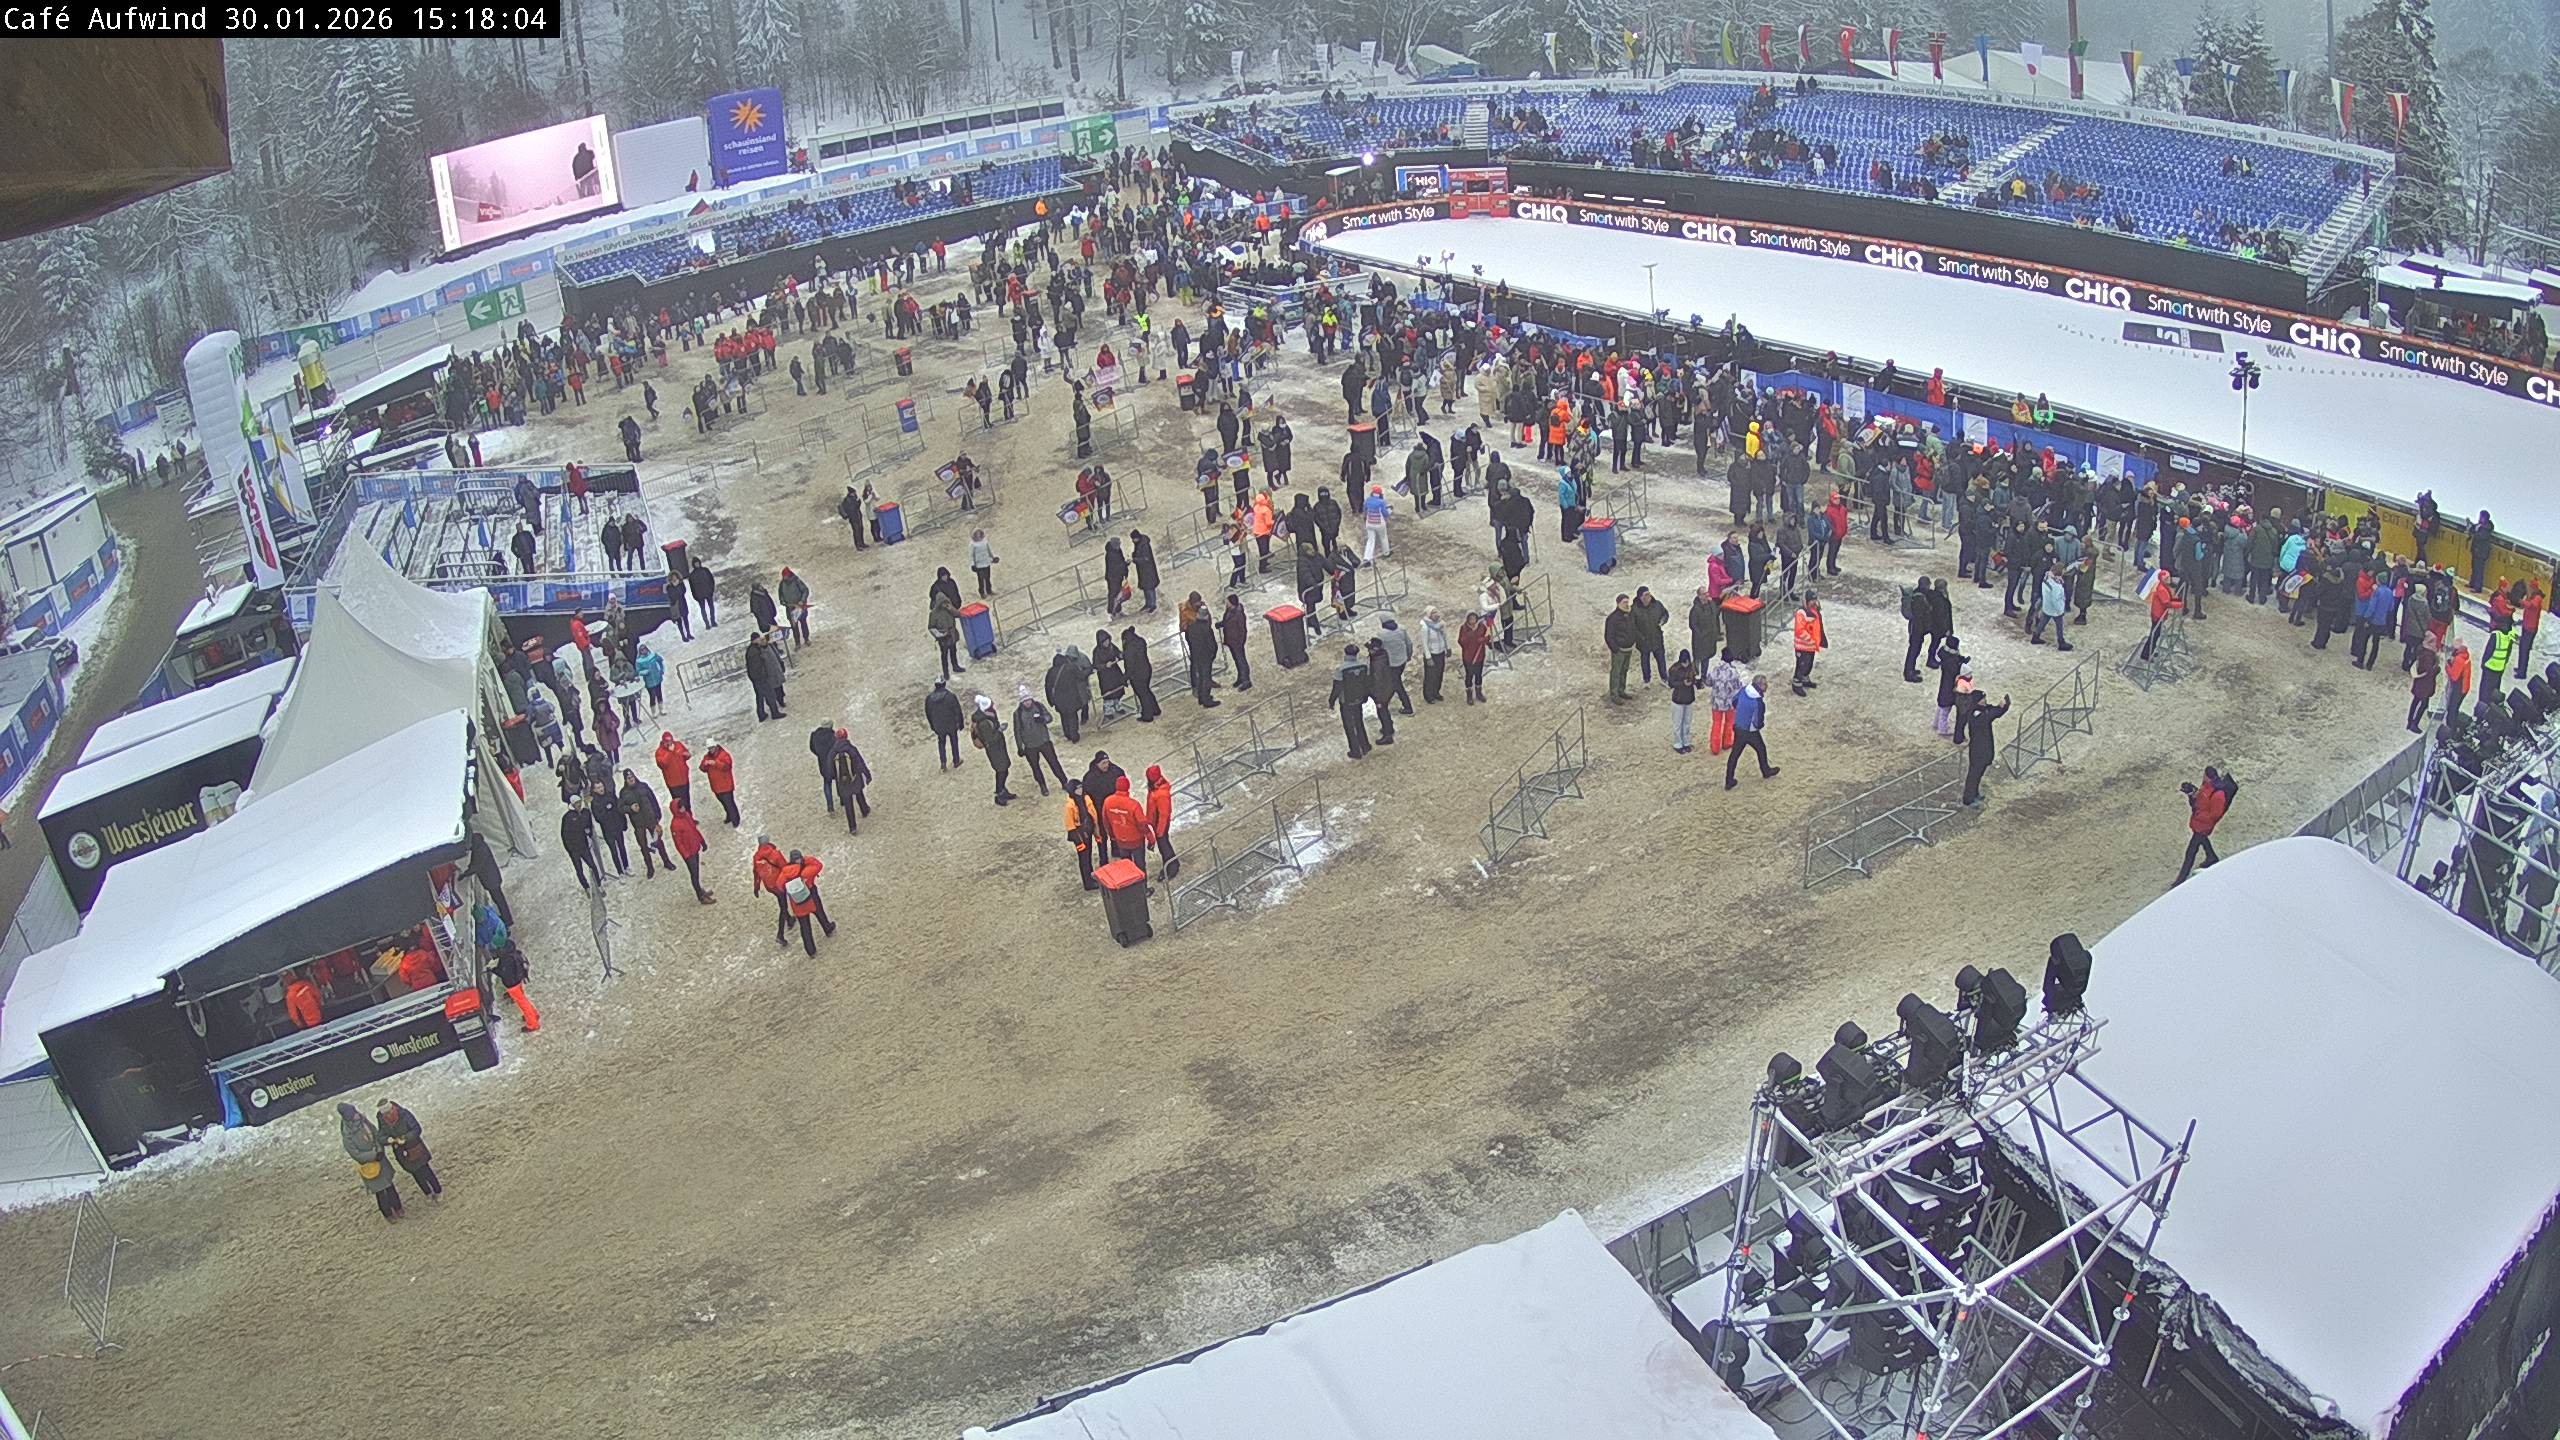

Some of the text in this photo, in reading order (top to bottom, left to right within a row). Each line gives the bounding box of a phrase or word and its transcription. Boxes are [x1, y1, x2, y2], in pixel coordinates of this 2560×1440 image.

[2140, 114, 2150, 122] An
[2152, 116, 2178, 127] Hessen
[2200, 122, 2214, 132] kein
[2215, 125, 2231, 137] Weg
[723, 133, 777, 151] schauinsland
[738, 145, 764, 156] reisen
[2277, 136, 2287, 145] An
[2289, 138, 2316, 150] Hessen
[1343, 213, 1377, 230] Smart
[1378, 208, 1403, 223] with
[1404, 205, 1435, 222] Style
[564, 252, 574, 262] An
[575, 247, 602, 261] Hessen
[1579, 209, 1613, 226] Smart
[1614, 213, 1639, 229] with
[1641, 216, 1669, 234] Style
[1750, 229, 1788, 248] Smart
[1790, 235, 1817, 252] with
[1820, 238, 1850, 257] Style
[1938, 256, 1980, 278] Smart
[1982, 265, 2011, 283] with
[2015, 269, 2049, 290] Style
[2148, 294, 2194, 319] Smart
[2196, 305, 2229, 326] with
[2233, 311, 2272, 335] Style
[2379, 341, 2429, 368] Smart
[2430, 353, 2466, 376] with
[2469, 361, 2509, 388] Style
[2526, 376, 2560, 404] CH
[101, 802, 198, 855] Warsteiner
[387, 1032, 440, 1058] Warsteiner
[266, 1073, 317, 1100] Warsteiner
